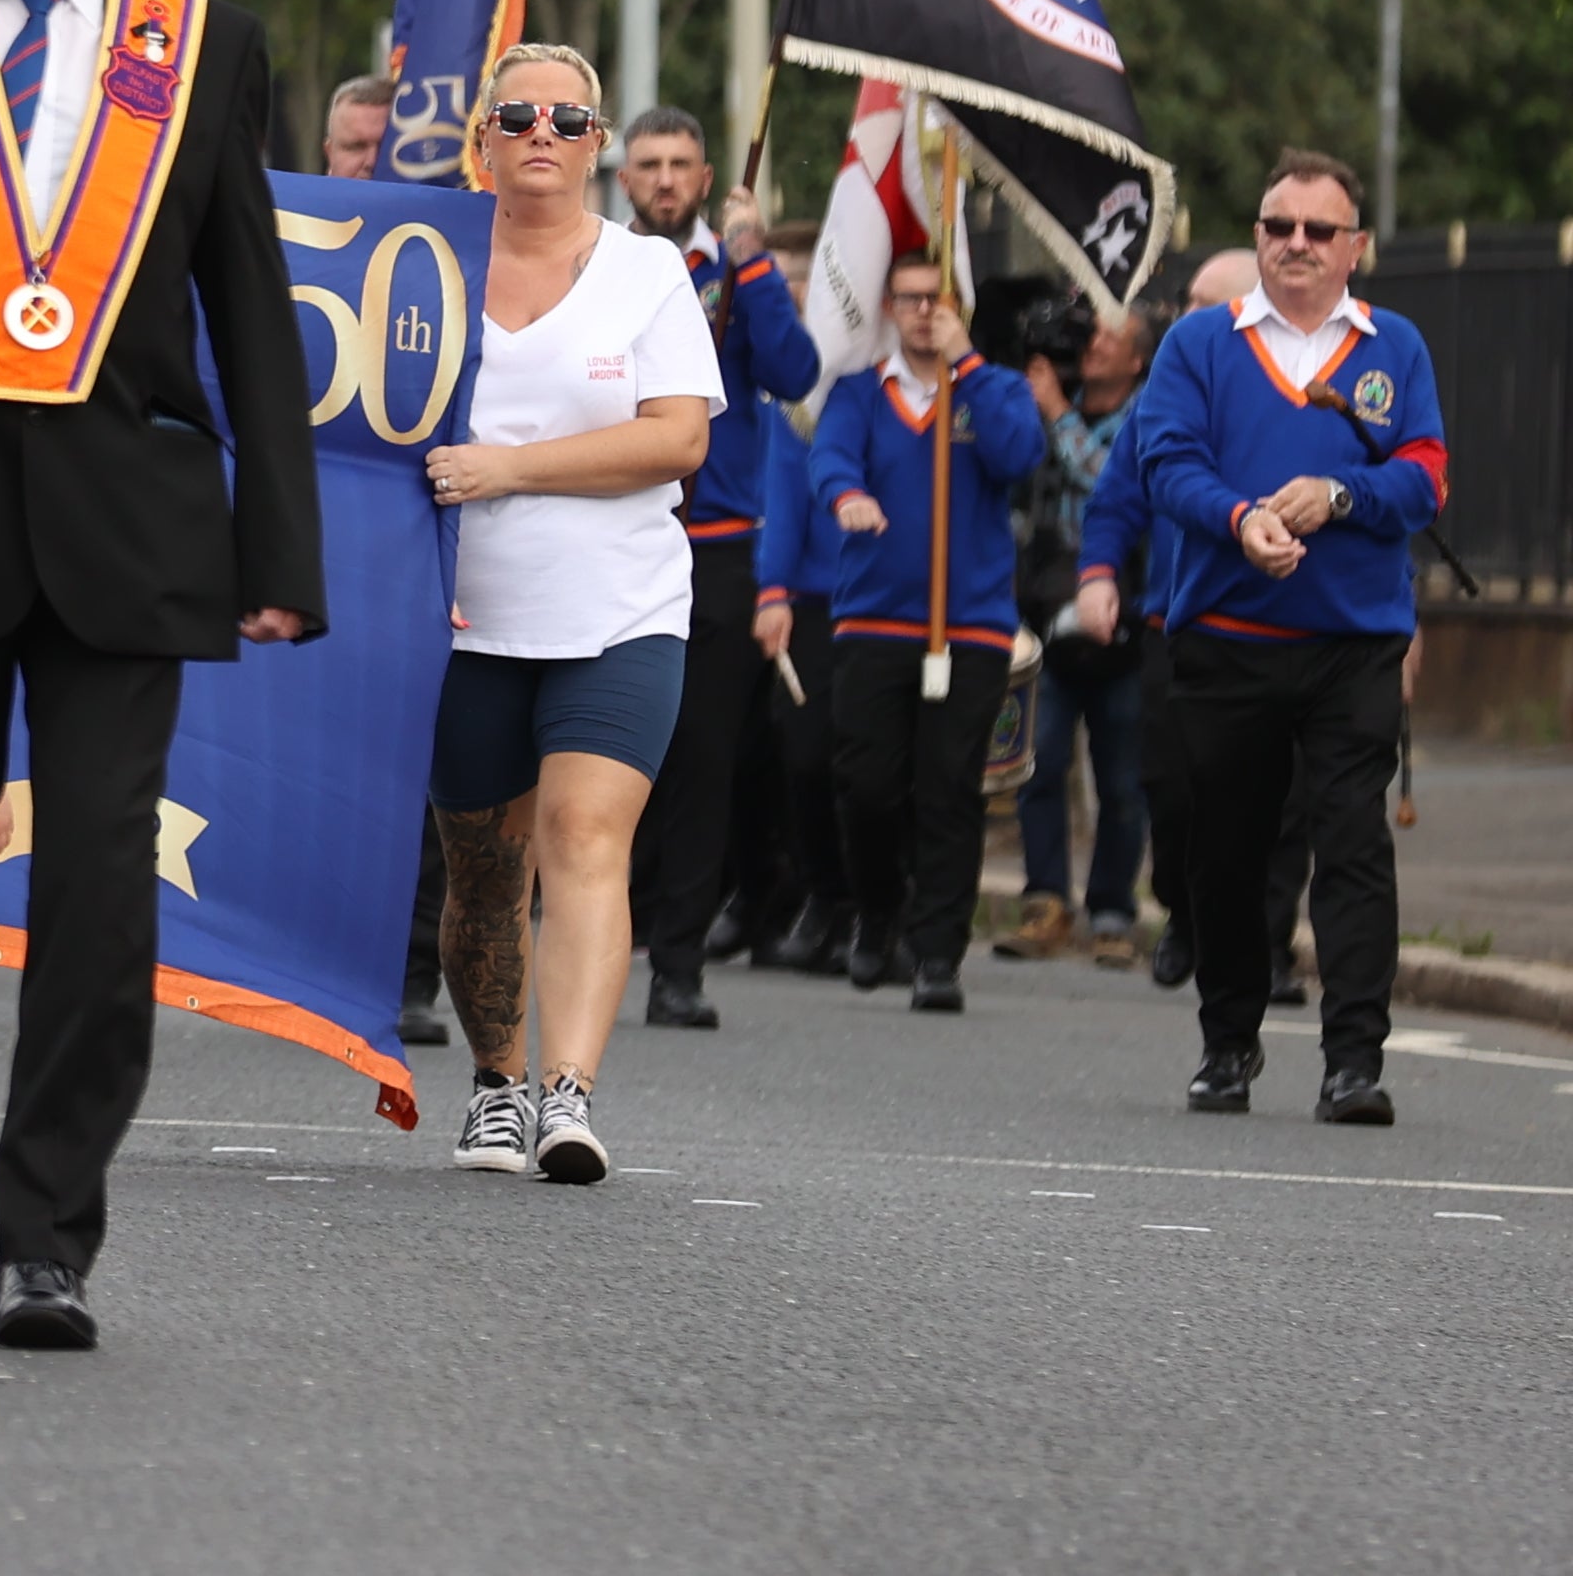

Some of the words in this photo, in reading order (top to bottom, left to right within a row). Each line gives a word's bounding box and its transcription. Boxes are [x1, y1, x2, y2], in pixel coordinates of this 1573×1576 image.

[1030, 6, 1065, 33] OF
[586, 354, 626, 367] LOYALIST
[588, 368, 627, 381] ARDOYNE
